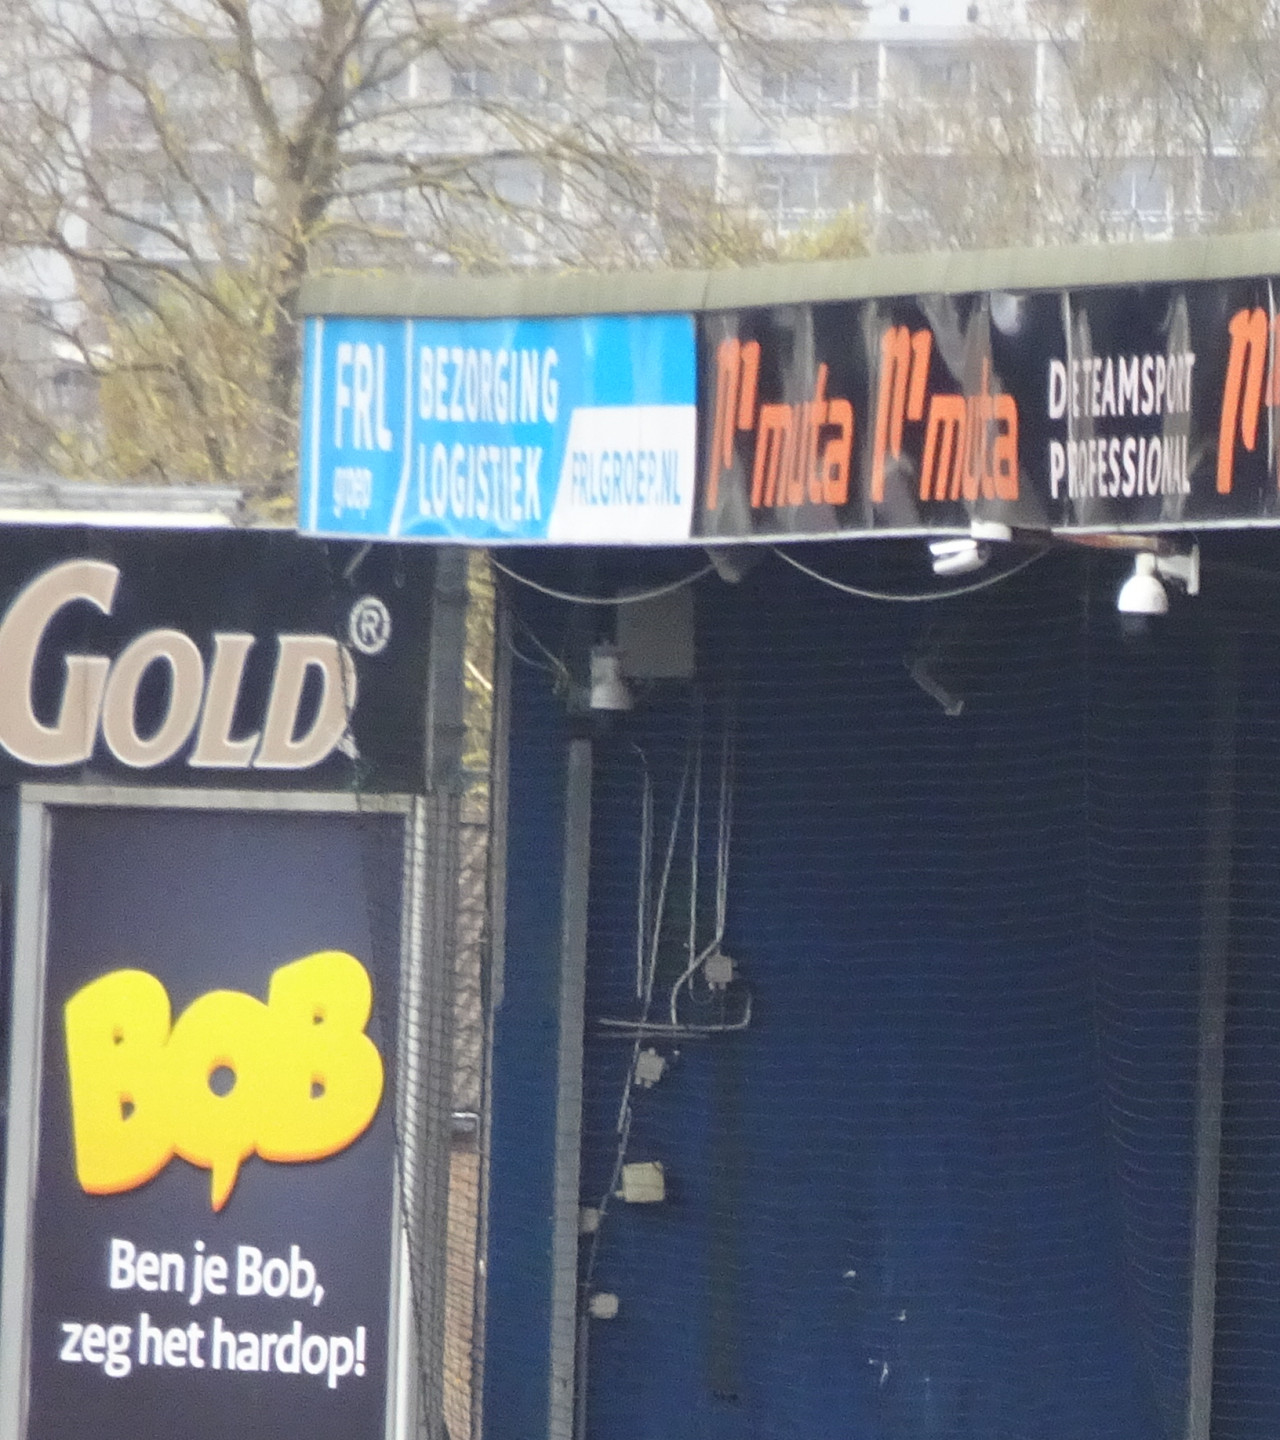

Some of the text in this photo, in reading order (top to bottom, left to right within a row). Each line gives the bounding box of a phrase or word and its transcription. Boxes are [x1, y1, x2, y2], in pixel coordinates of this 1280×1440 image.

[334, 342, 392, 451] FRL
[418, 346, 560, 424] BEZORGING
[418, 442, 544, 522] LOGISTIEK
[572, 449, 681, 507] FRLGROEP.NL
[1049, 435, 1191, 499] PROFESSIONAL
[109, 1238, 324, 1307] Ben je Bob,
[59, 1312, 366, 1389] zeg het hardop!
